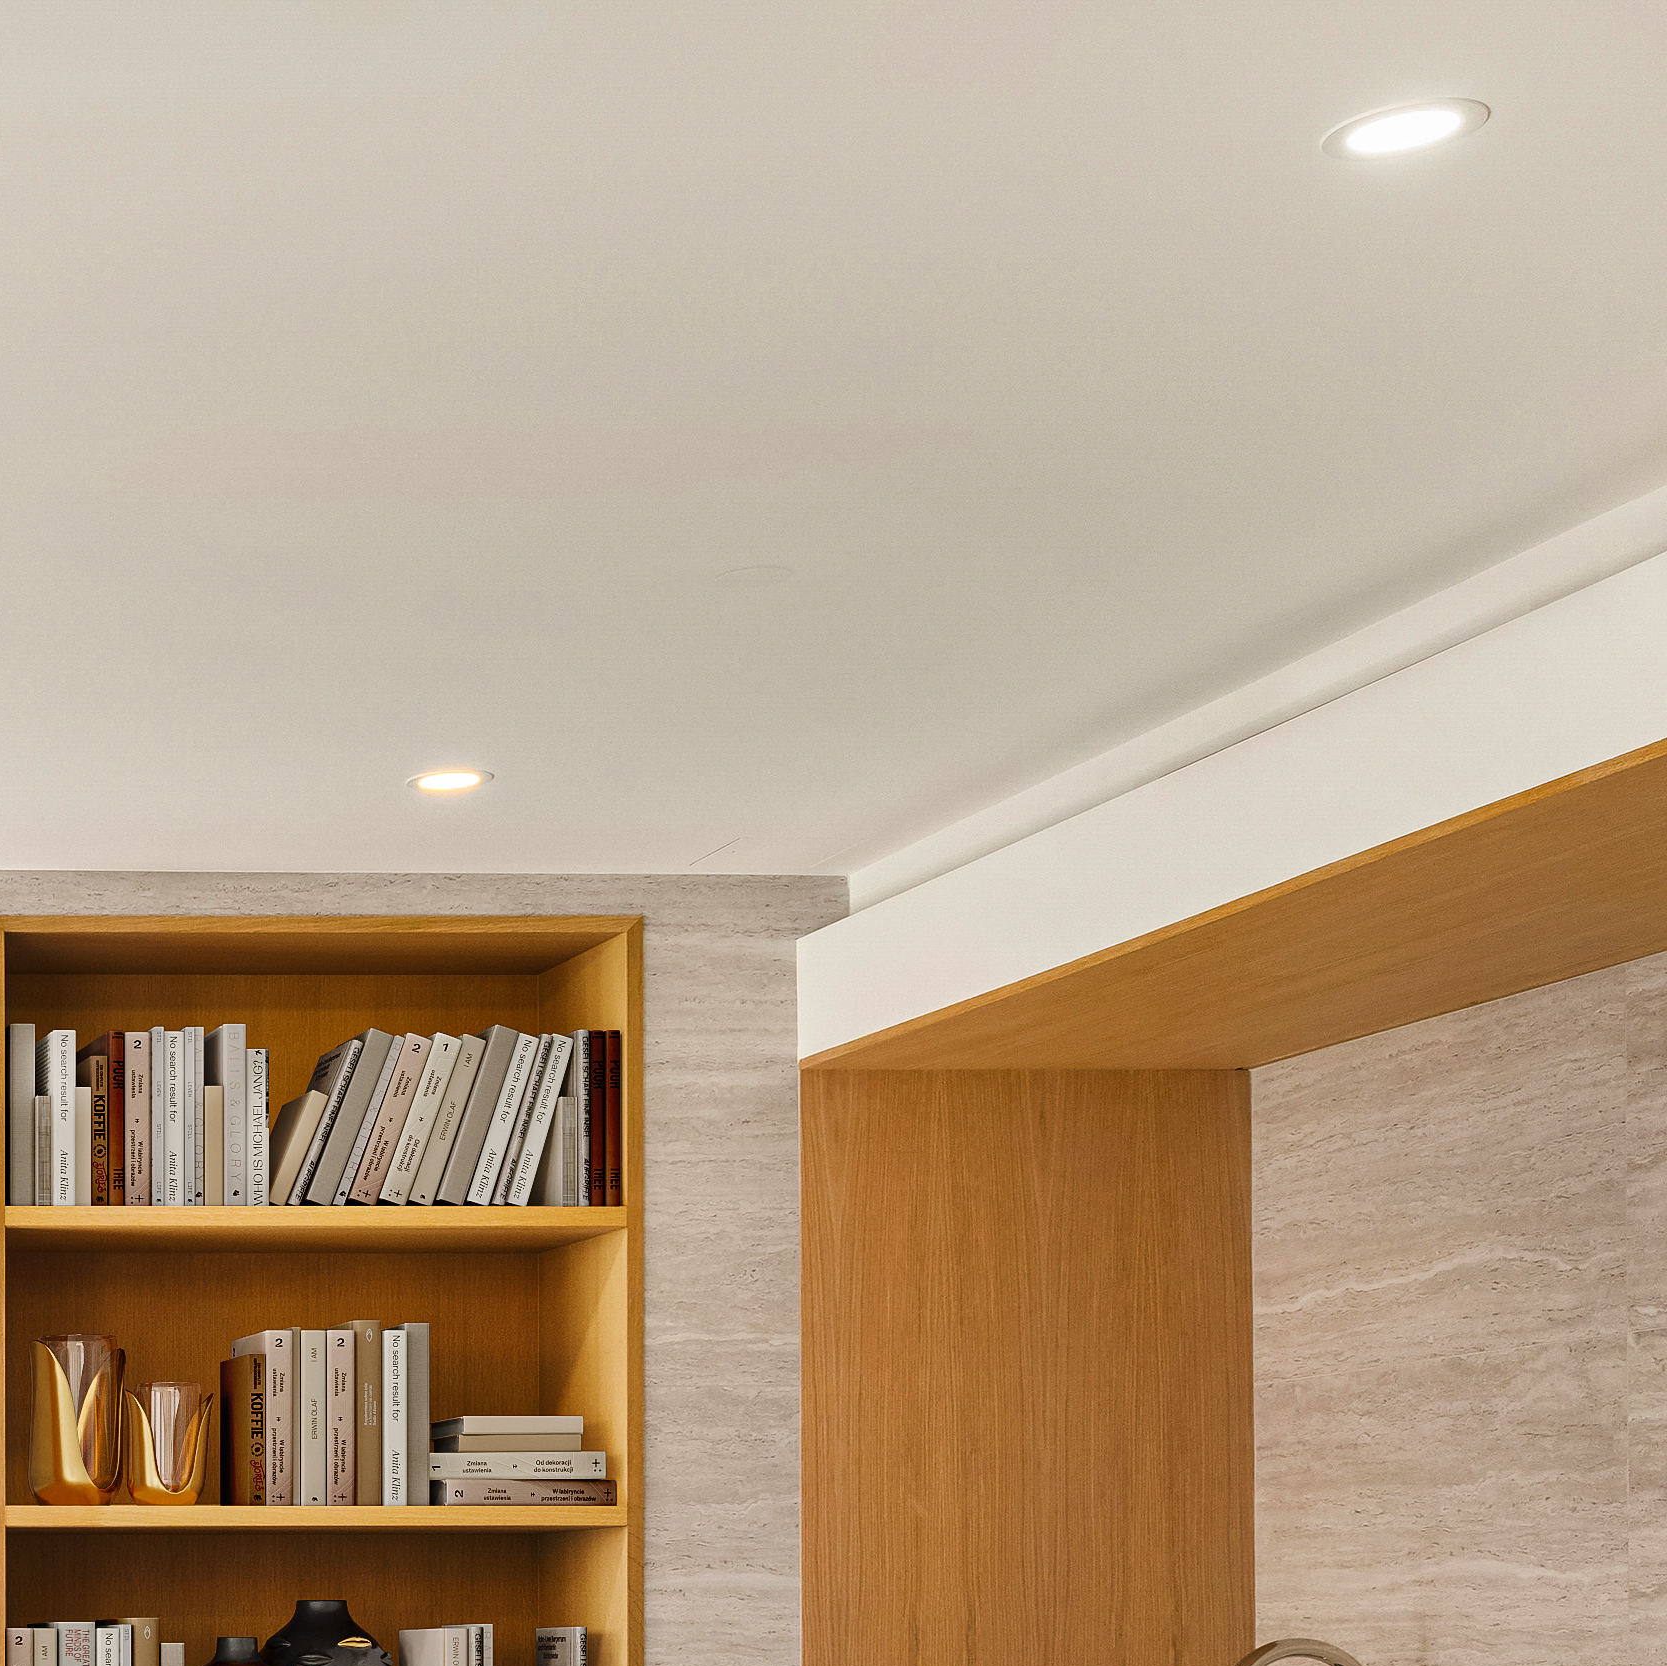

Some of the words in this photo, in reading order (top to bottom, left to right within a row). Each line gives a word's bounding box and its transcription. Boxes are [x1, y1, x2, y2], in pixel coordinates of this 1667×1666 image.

[93, 1095, 106, 1141] KOFFIE
[392, 1335, 401, 1348] No
[392, 1349, 401, 1380] search
[392, 1382, 401, 1407] result
[250, 1393, 263, 1439] KOFFIE
[391, 1409, 401, 1422] for
[391, 1449, 401, 1475] Anita
[391, 1476, 401, 1502] Klinz
[454, 1489, 464, 1498] 2
[64, 1629, 74, 1657] FUTURE
[73, 1629, 82, 1652] MINDS
[81, 1629, 91, 1644] THE
[73, 1652, 82, 1663] OF
